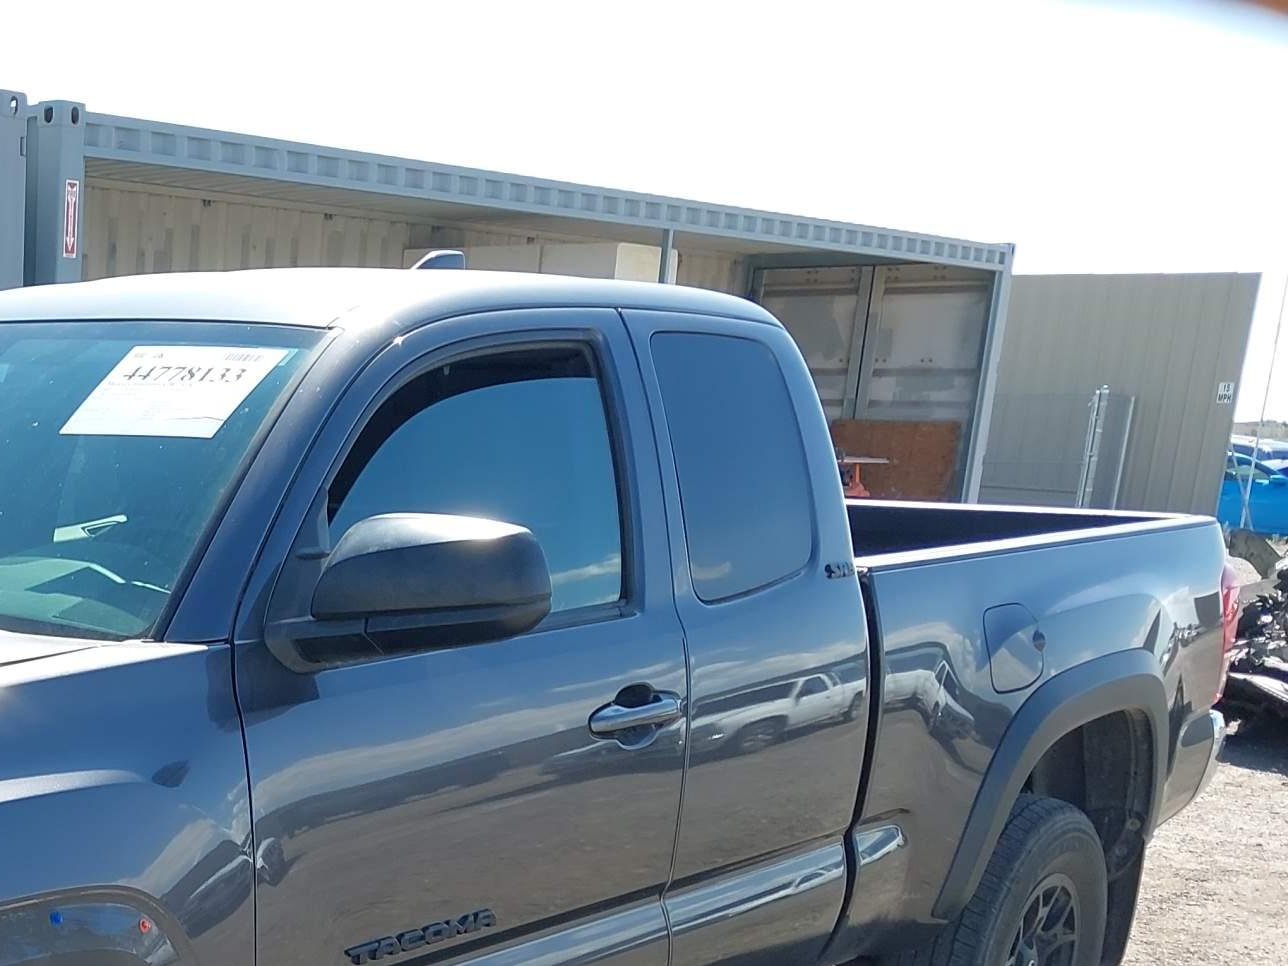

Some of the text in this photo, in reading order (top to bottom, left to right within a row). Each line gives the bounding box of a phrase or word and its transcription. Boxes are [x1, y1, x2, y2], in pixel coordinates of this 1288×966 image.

[123, 366, 247, 382] 44778133
[1217, 393, 1232, 401] MPH
[344, 908, 496, 965] TACOMA
